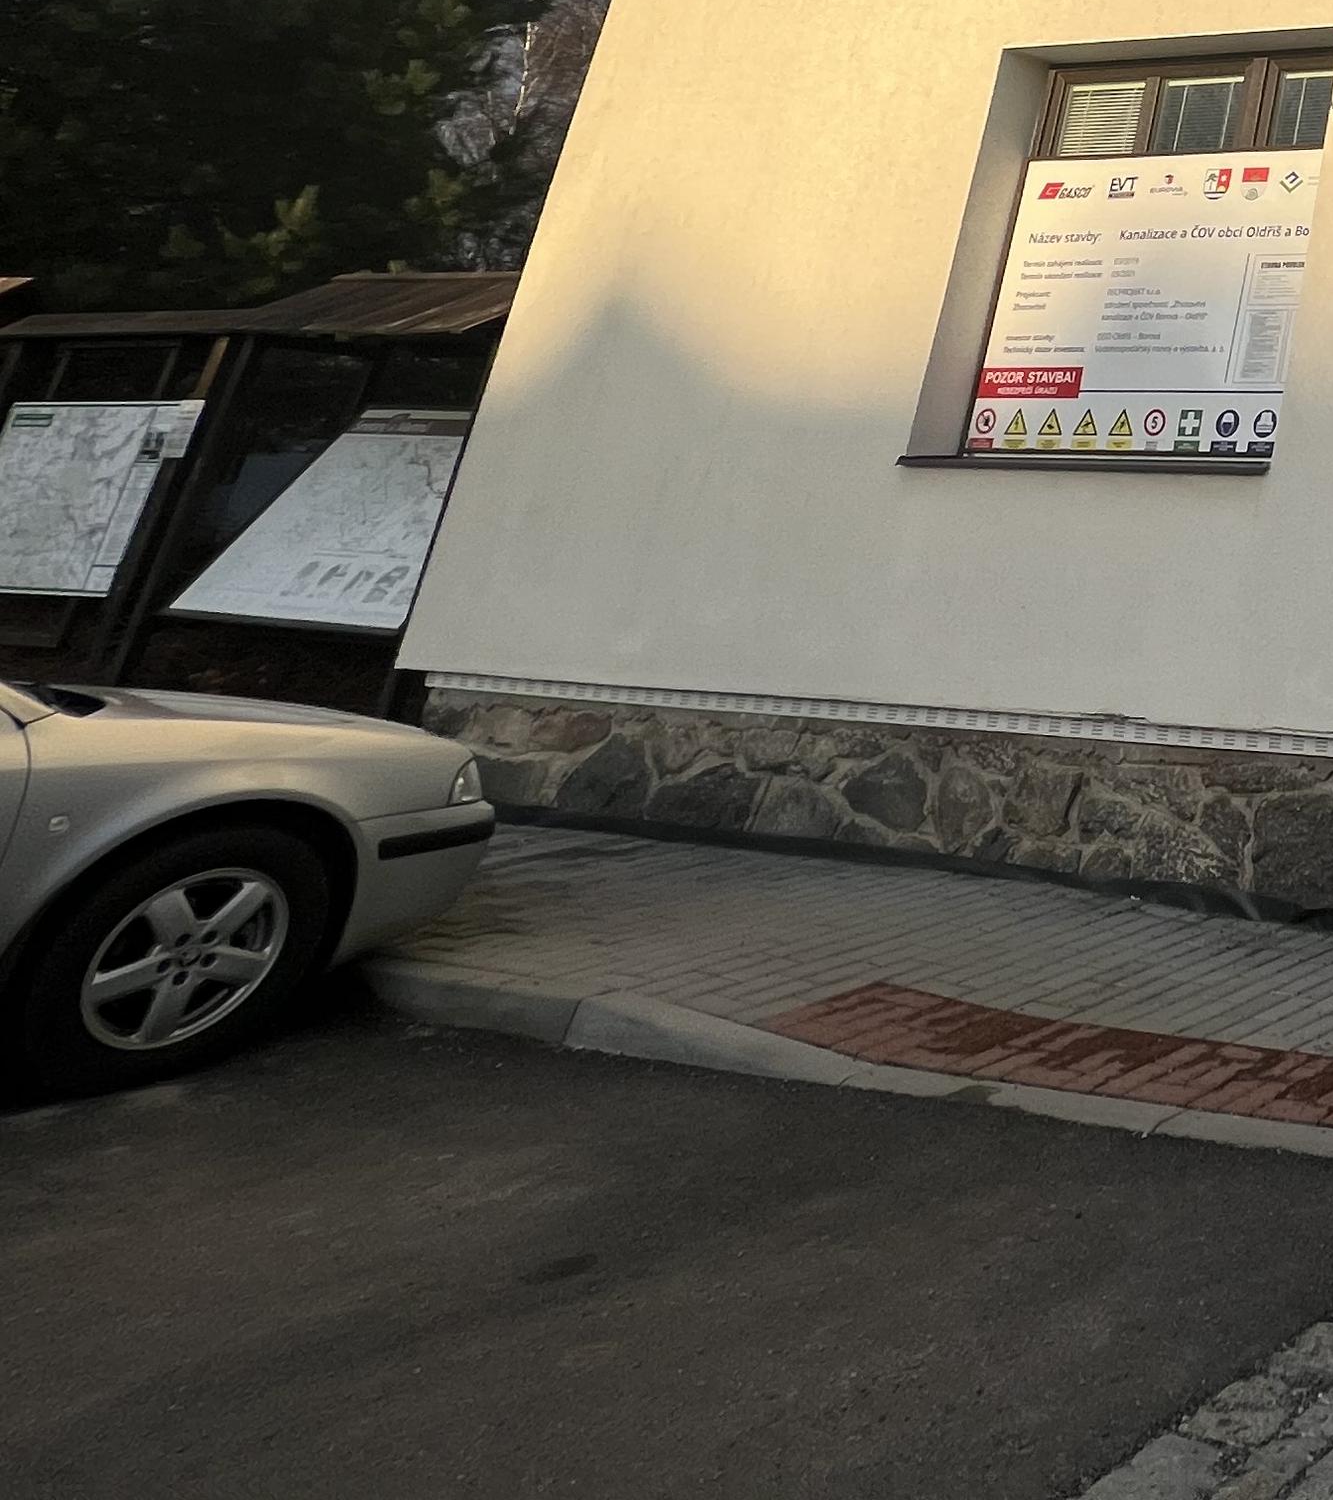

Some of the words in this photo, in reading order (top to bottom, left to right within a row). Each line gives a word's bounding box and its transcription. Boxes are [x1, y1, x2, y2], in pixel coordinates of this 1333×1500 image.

[1110, 176, 1139, 192] EVT
[1120, 228, 1178, 241] Kanalizace
[1190, 224, 1216, 239] ČOV
[985, 370, 1024, 384] POZOR
[1151, 416, 1159, 430] 5
